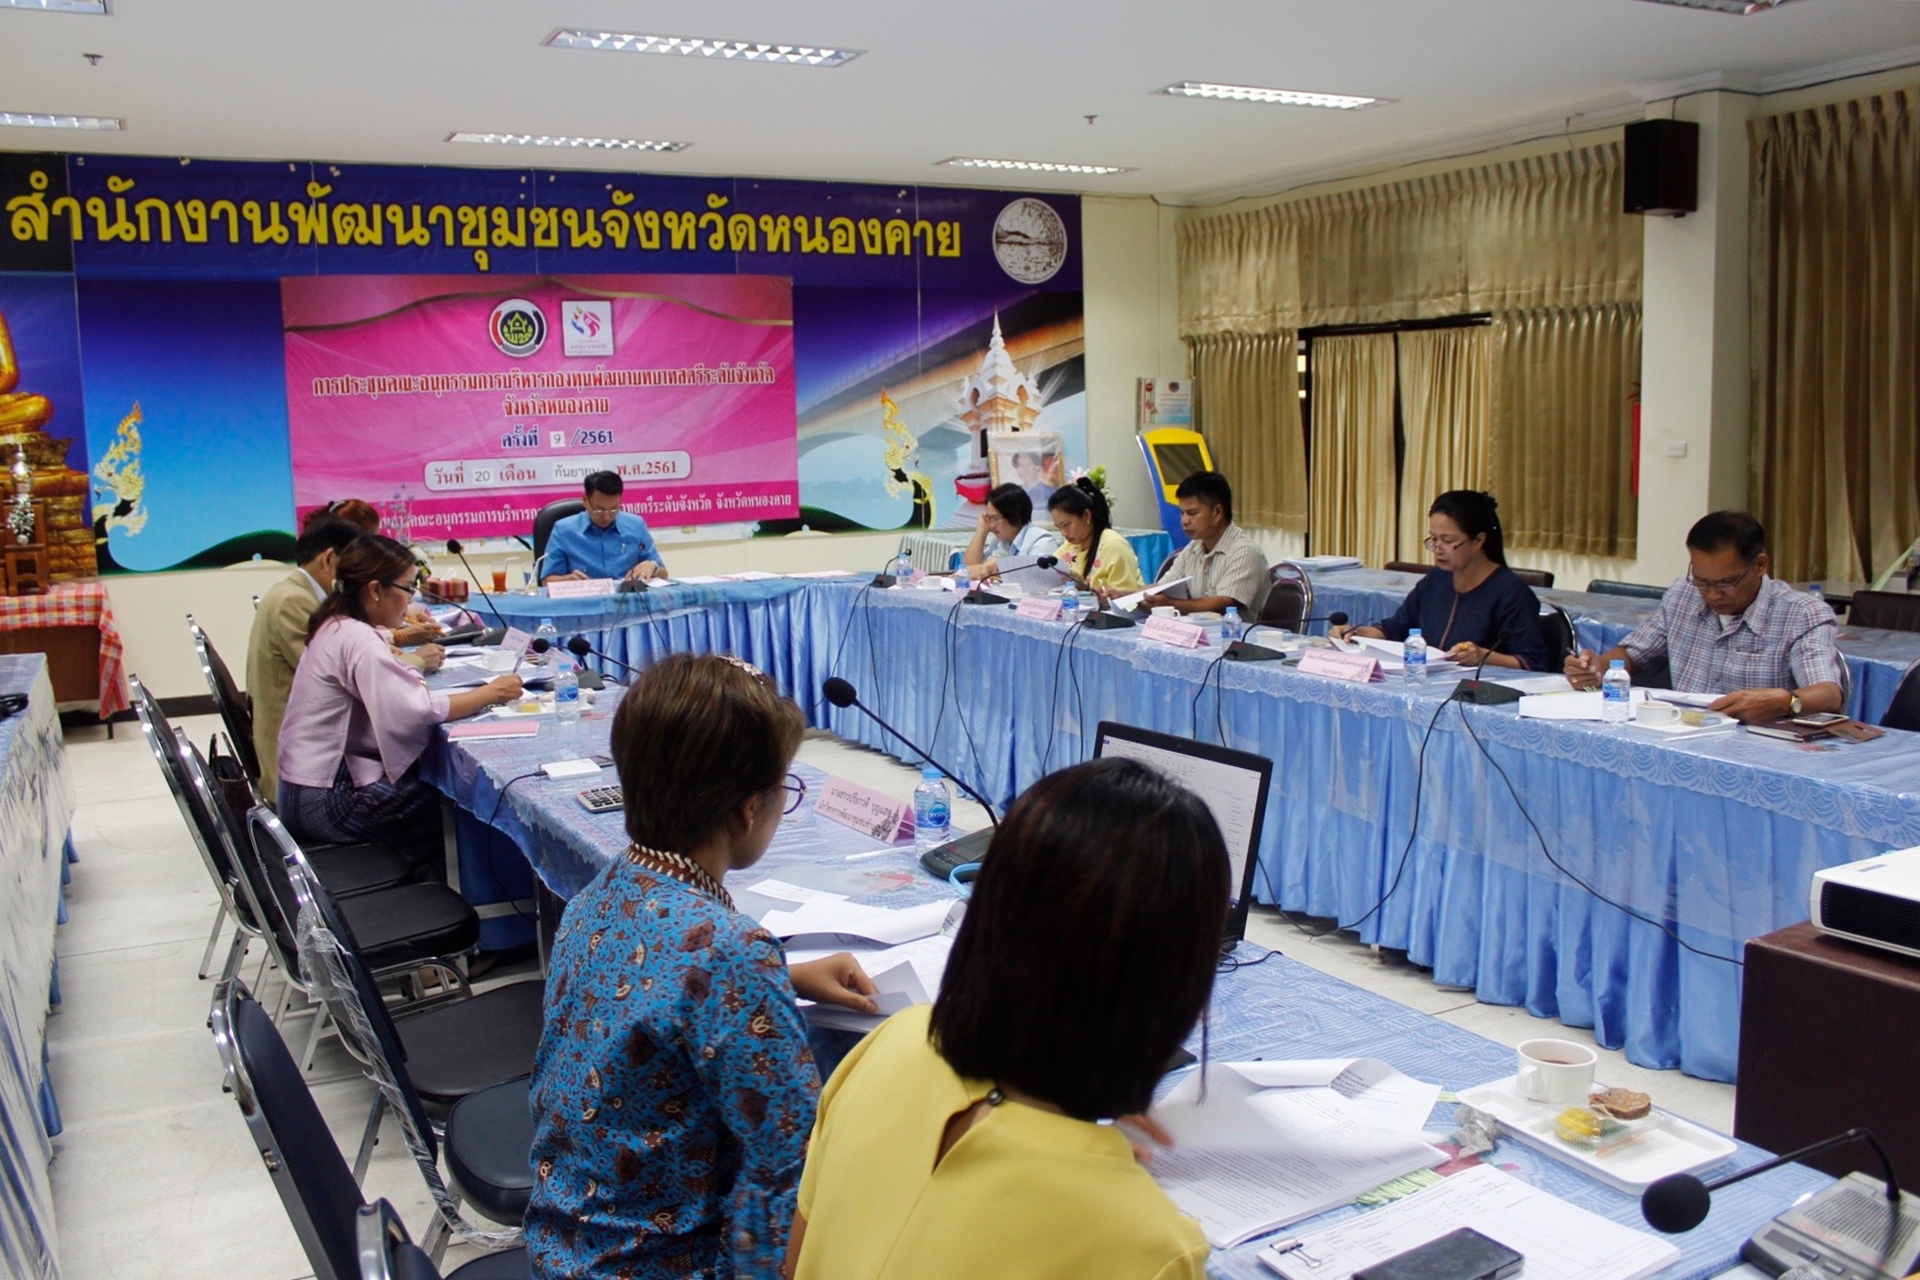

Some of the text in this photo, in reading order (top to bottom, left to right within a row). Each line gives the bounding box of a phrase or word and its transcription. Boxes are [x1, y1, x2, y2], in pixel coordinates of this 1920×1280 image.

[6, 171, 961, 271] สำนักงานพัฒนาชุมชนจังหวัดหนองคาย
[312, 363, 775, 399] การประชุมคณะอนุกรรมการบริหารกองทุนพัฒนาบทบาทสตรีระดับจังหวัด
[503, 395, 610, 416] จังหวัดหนองคาย
[502, 425, 538, 448] ครั้งที่
[553, 433, 561, 445] 9
[434, 461, 464, 484] วันที่
[475, 470, 490, 482] 20
[500, 463, 536, 481] เดือน
[716, 491, 792, 516] จังหวัดหนองคาย
